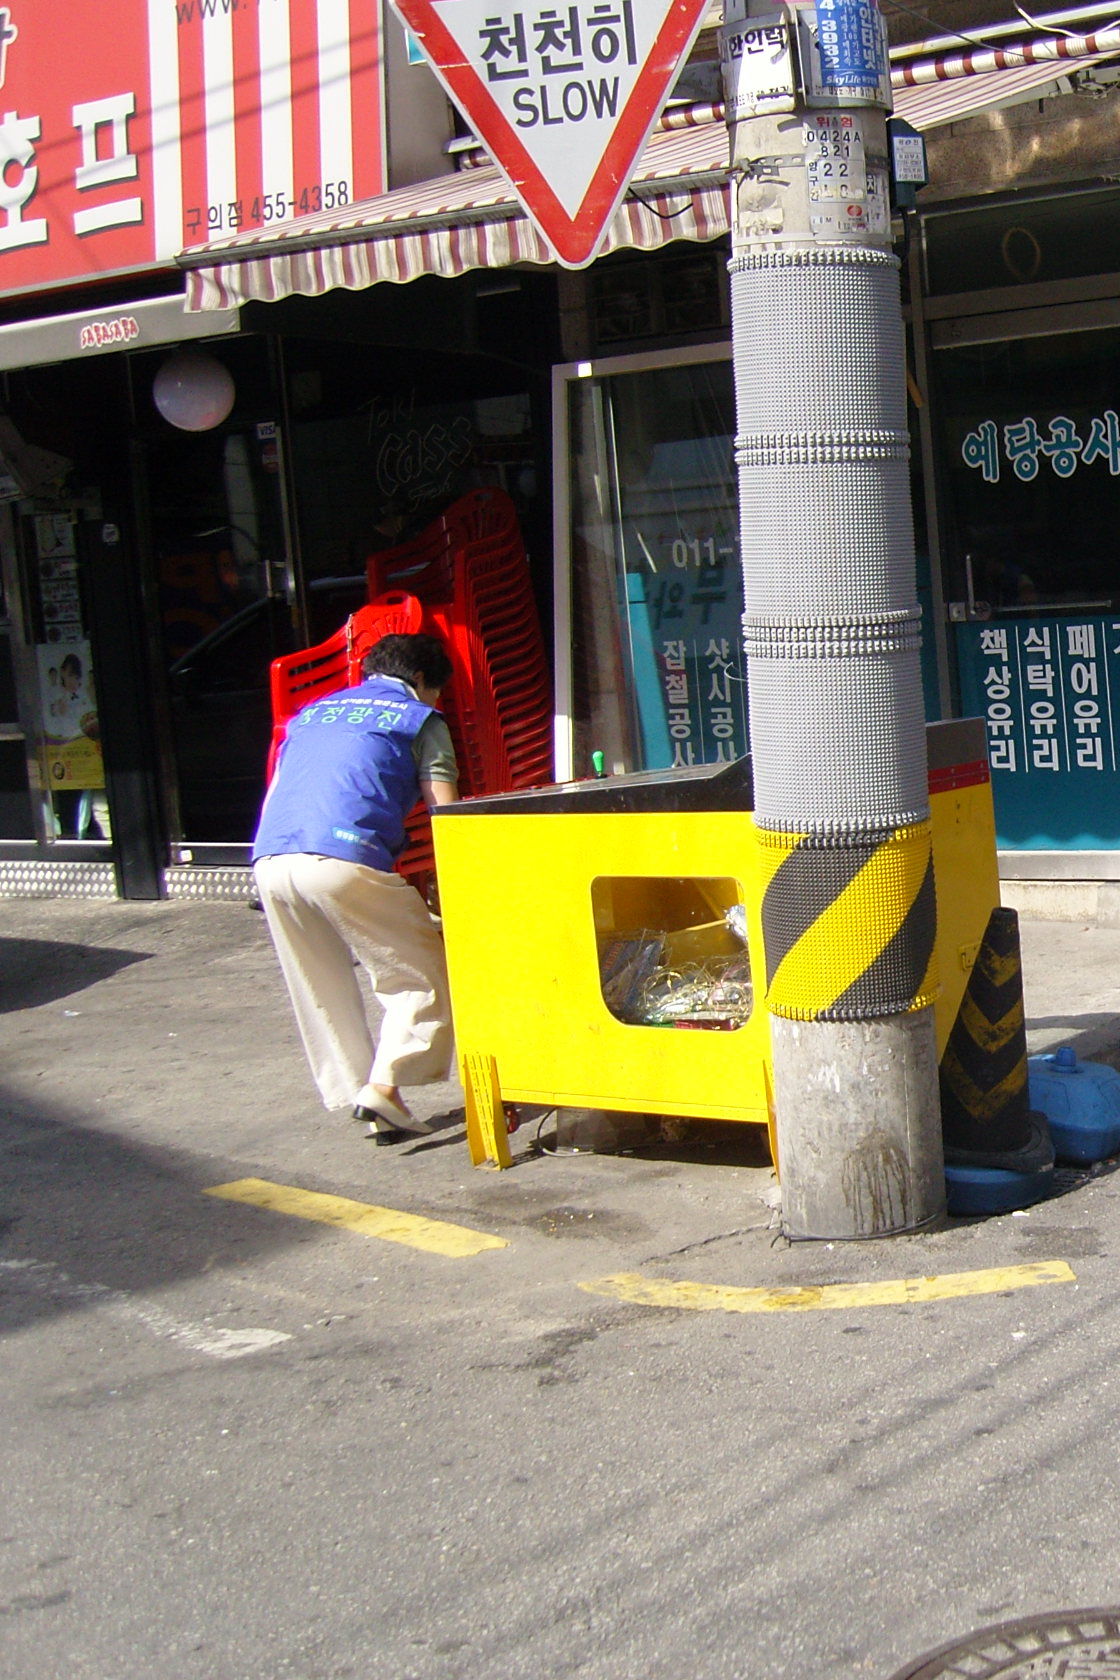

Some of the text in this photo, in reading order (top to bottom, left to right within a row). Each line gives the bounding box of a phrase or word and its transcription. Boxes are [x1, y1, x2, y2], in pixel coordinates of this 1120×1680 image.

[479, 0, 639, 82] 천천히
[513, 76, 620, 128] SLOW
[807, 130, 861, 143] 0424A
[821, 145, 850, 158] 821
[824, 162, 849, 177] 22
[186, 180, 349, 236] 구의점 455-4358
[81, 316, 140, 349] SABASABA
[663, 639, 696, 768] 잡철공사
[705, 638, 738, 764] 샷시공사
[979, 626, 1017, 773] 책상유리
[1023, 625, 1061, 772] 식탁유리
[1066, 624, 1106, 771] 페어유리
